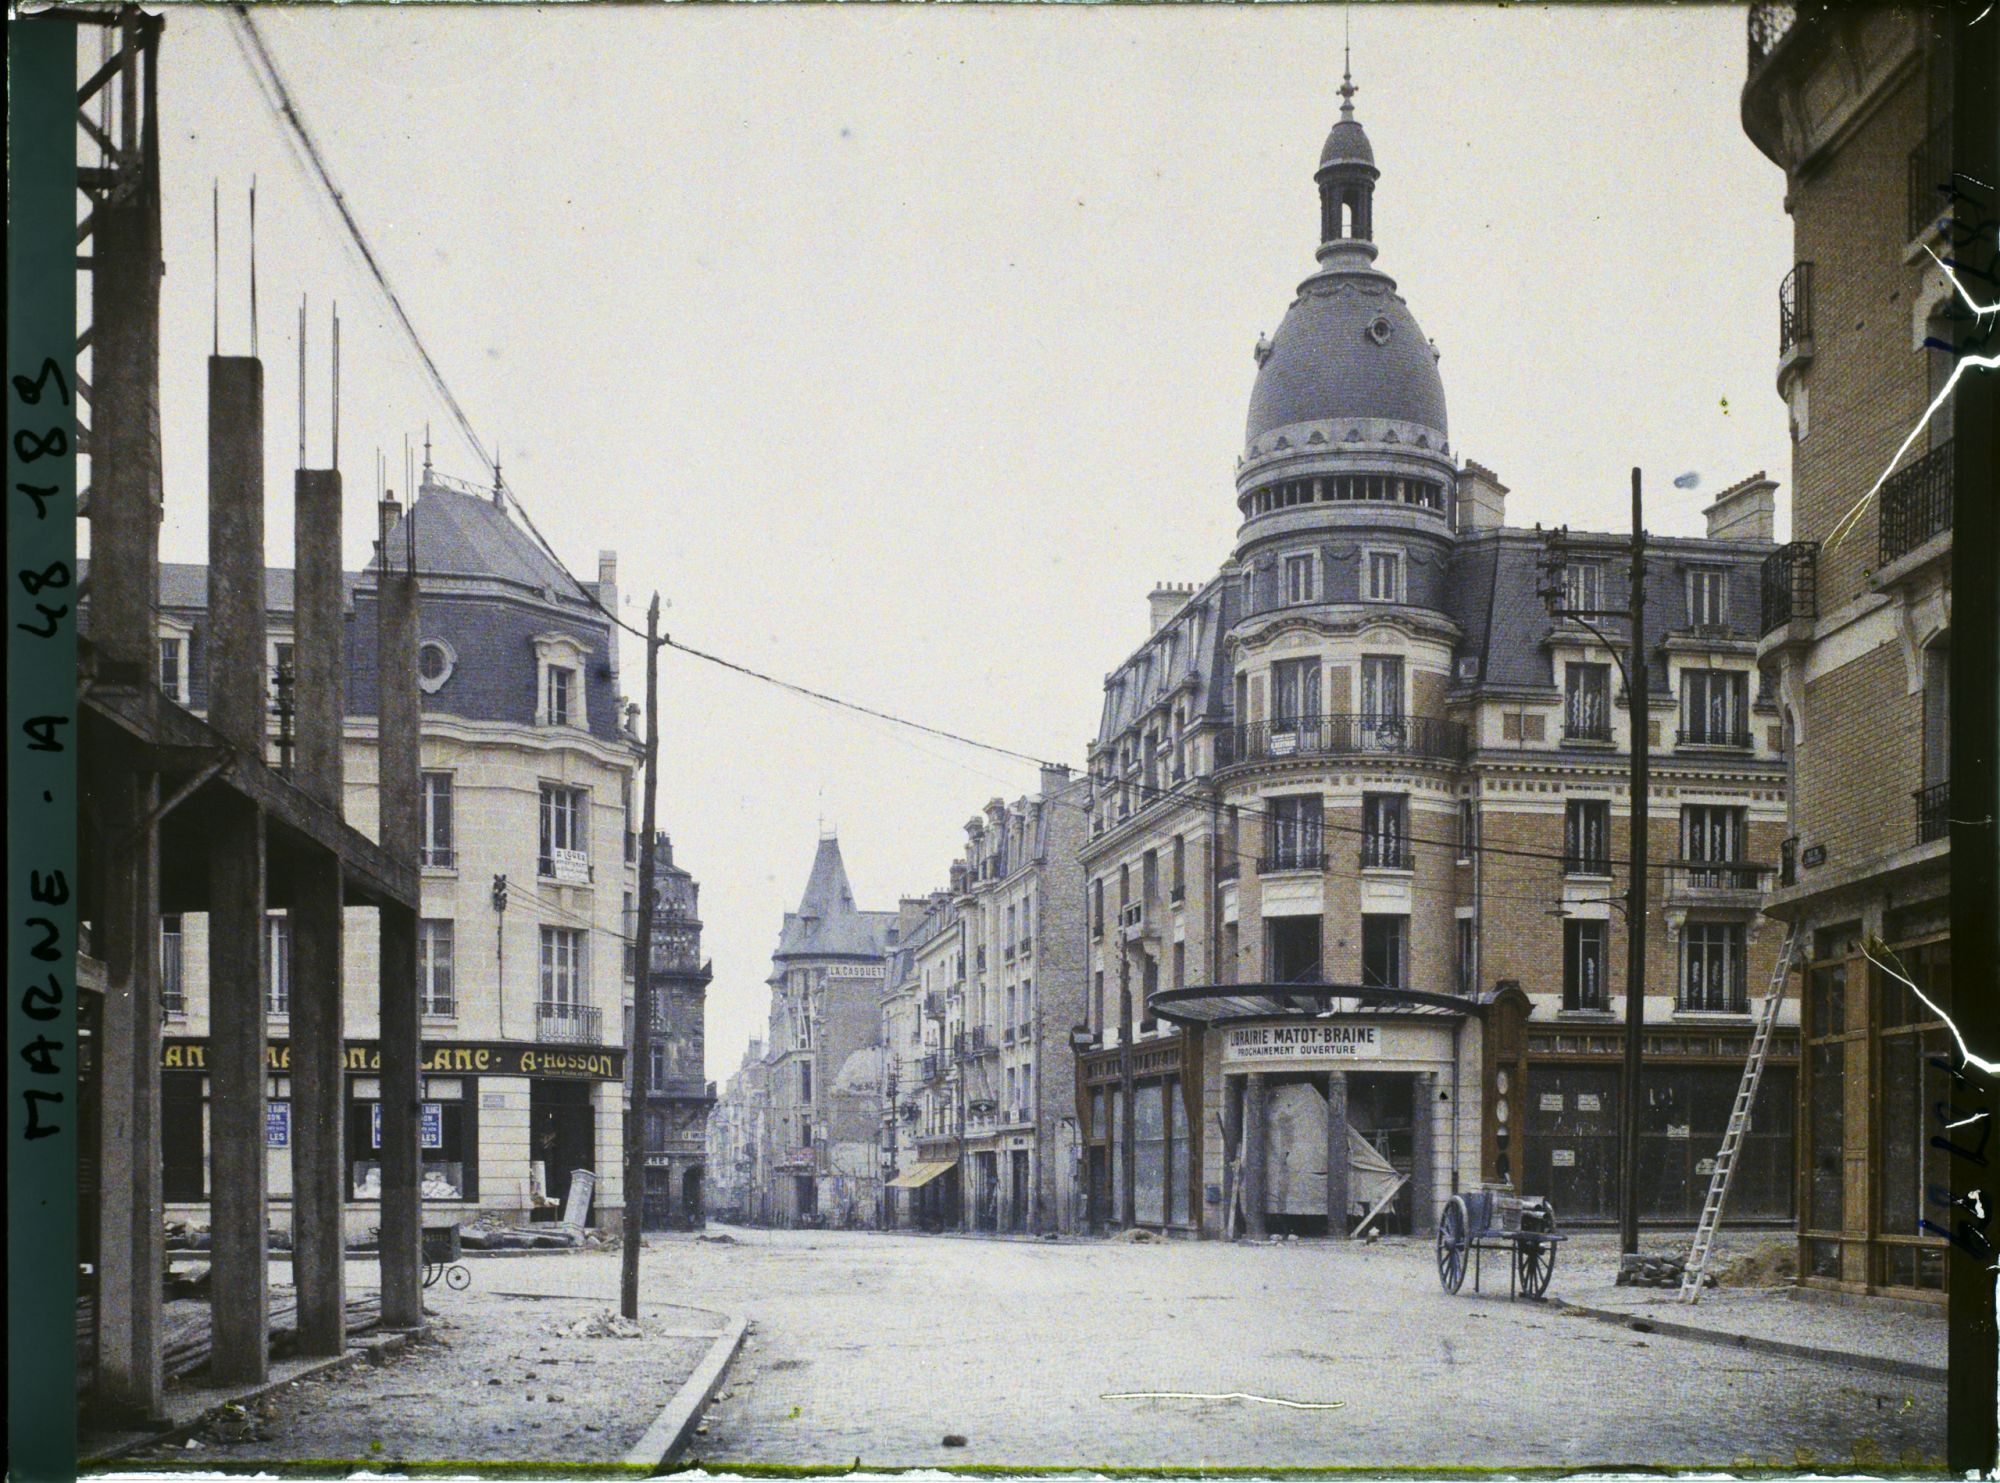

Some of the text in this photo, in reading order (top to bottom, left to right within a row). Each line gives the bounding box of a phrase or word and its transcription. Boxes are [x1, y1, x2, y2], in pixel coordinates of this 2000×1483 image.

[22, 715, 70, 753] A
[20, 868, 70, 1141] MARNE
[1230, 1027, 1375, 1047] LIBRAIRIE MATOT-BRAINE
[1237, 1044, 1356, 1057] PROCHAINEMENT OUVERTURE
